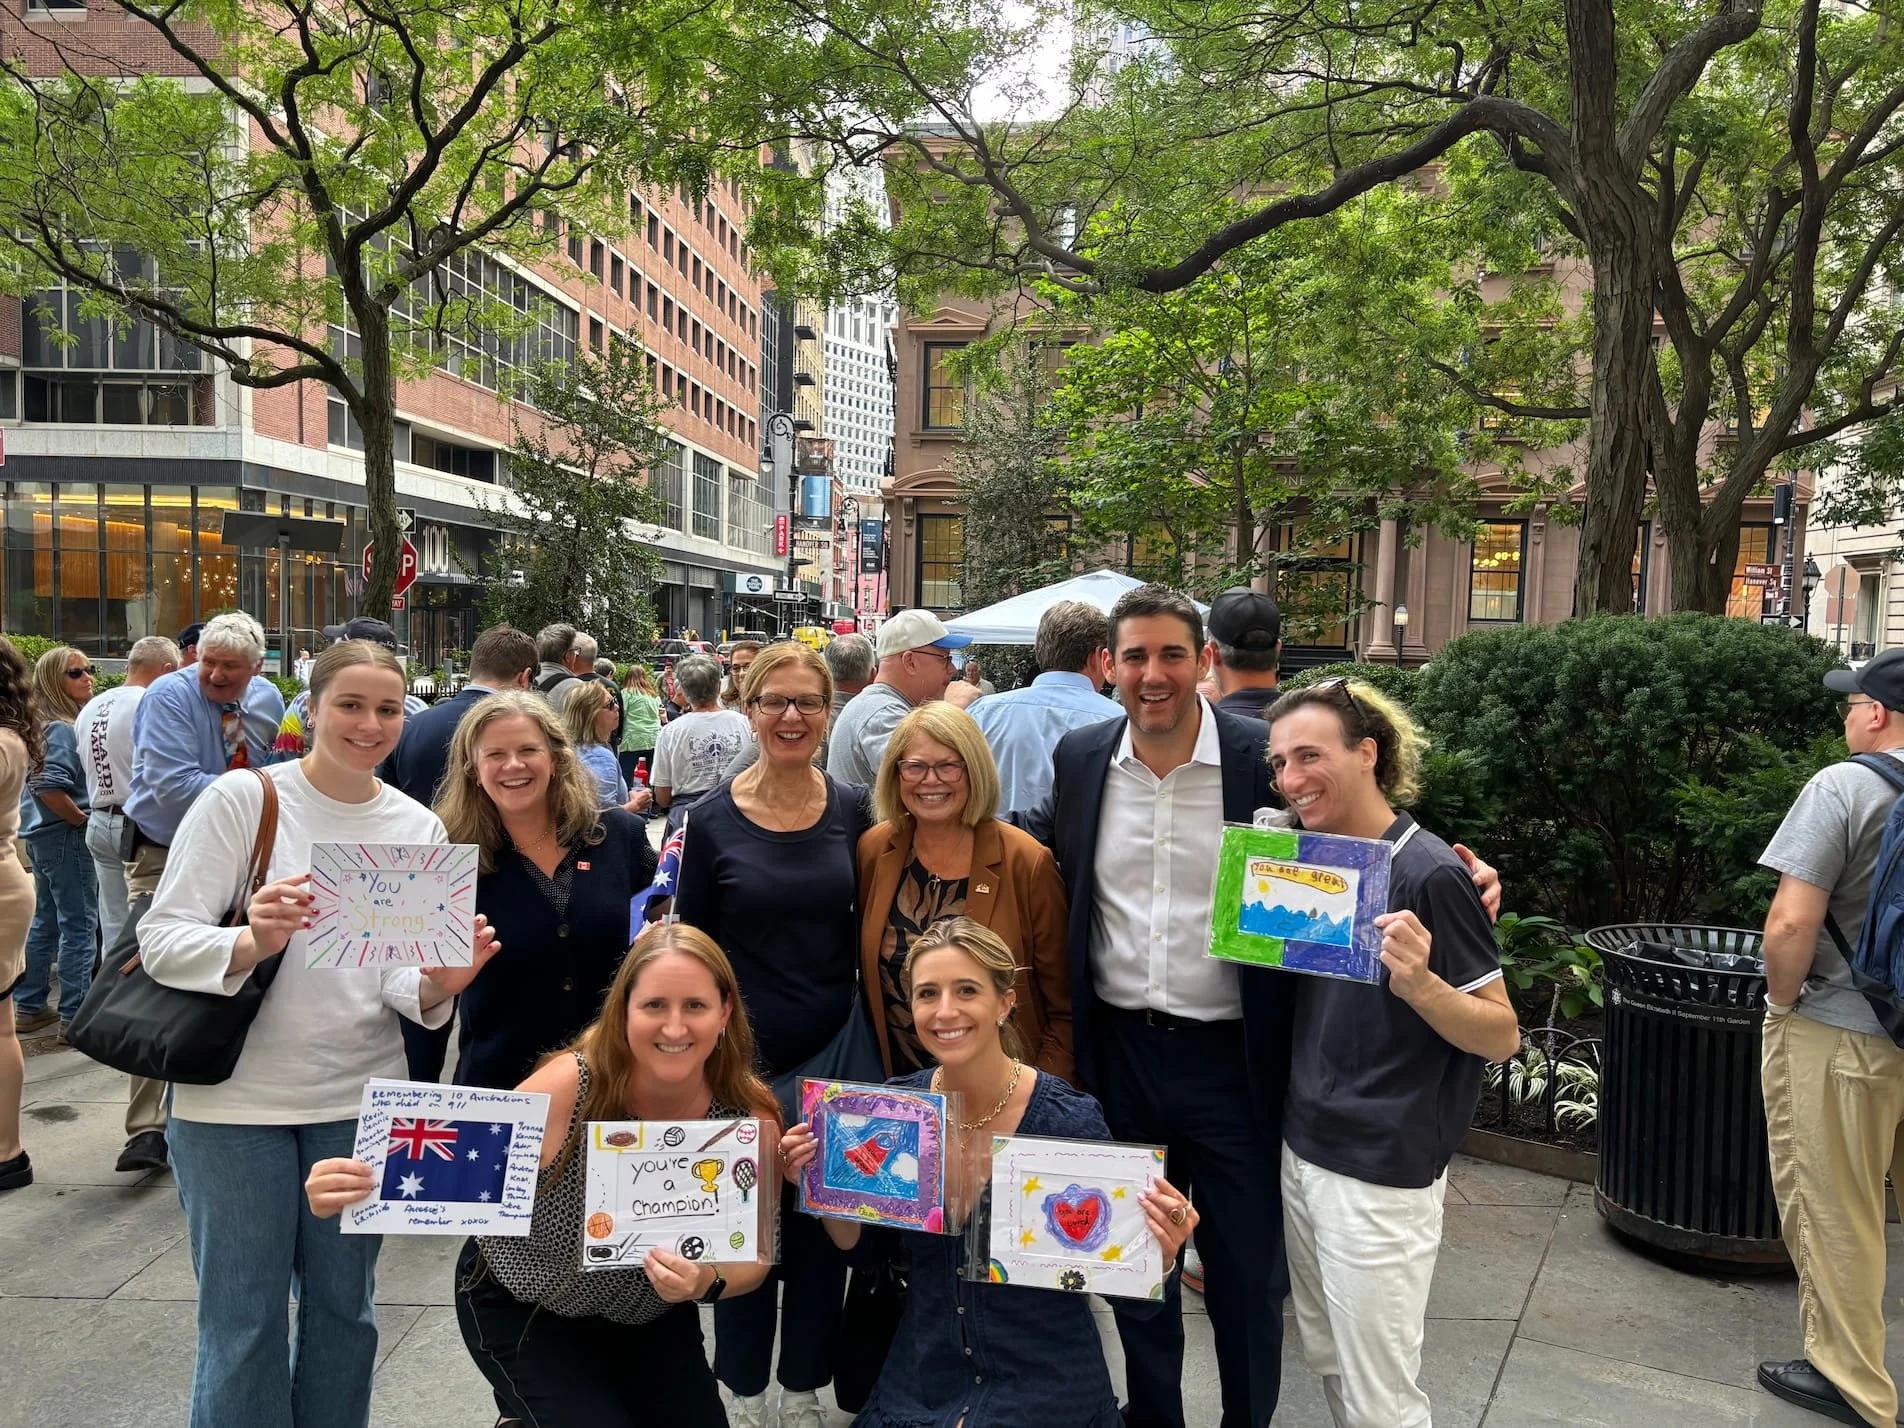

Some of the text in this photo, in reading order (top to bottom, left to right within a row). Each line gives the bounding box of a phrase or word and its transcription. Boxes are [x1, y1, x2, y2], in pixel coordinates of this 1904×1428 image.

[423, 525, 449, 573] 100
[1745, 577, 1768, 585] Hanover
[91, 721, 105, 788] NATION
[99, 720, 113, 789] PLAID
[373, 899, 394, 907] are
[351, 905, 424, 934] Strong
[1678, 1010, 1710, 1022] September
[1727, 1017, 1750, 1025] Garden
[663, 1179, 675, 1191] a
